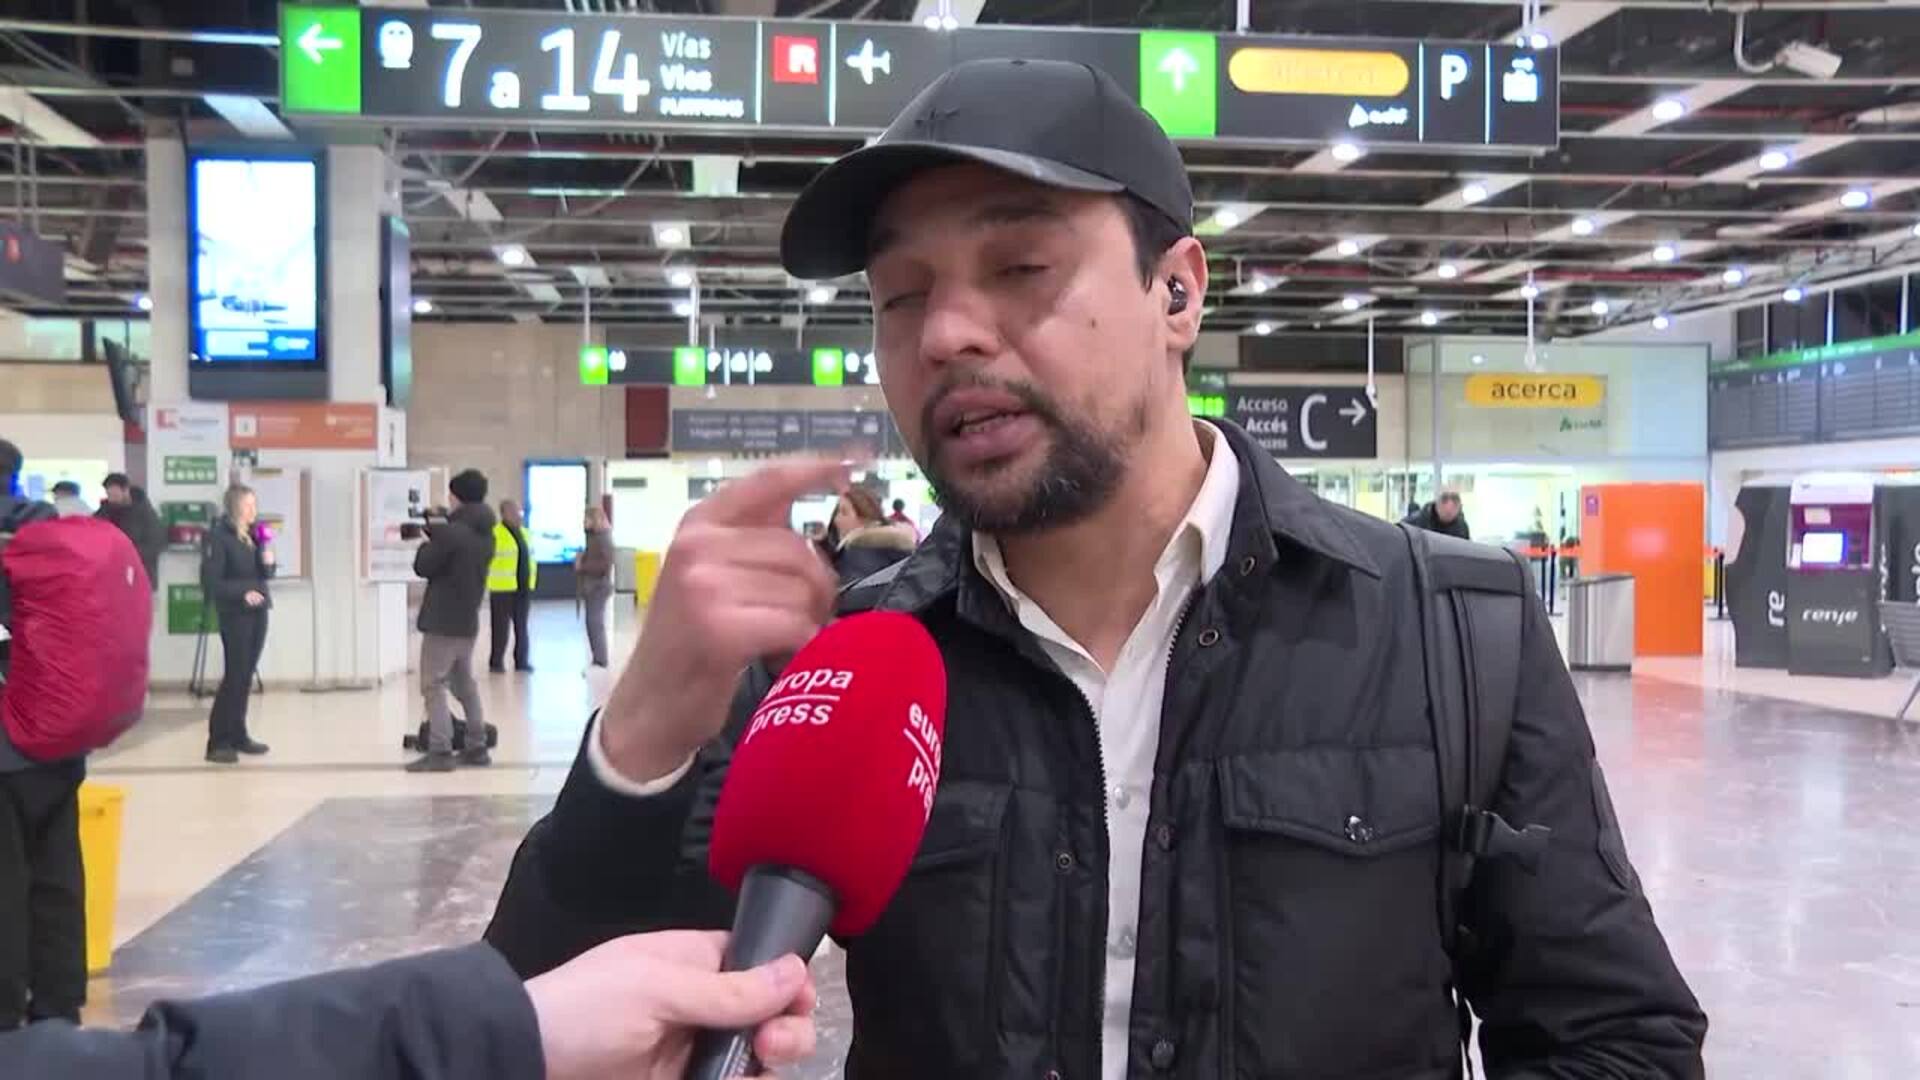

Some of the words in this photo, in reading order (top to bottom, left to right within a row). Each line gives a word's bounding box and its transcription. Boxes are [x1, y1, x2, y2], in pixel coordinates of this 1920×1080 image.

[661, 31, 711, 59] Vías
[431, 23, 482, 107] 7
[488, 70, 521, 109] a
[539, 26, 651, 113] 14
[1440, 54, 1468, 100] P
[1236, 396, 1288, 411] Acceso
[1491, 381, 1576, 399] acerca
[1245, 416, 1288, 434] Accés
[1300, 394, 1327, 450] C
[763, 668, 853, 702] uropa
[744, 703, 833, 745] press
